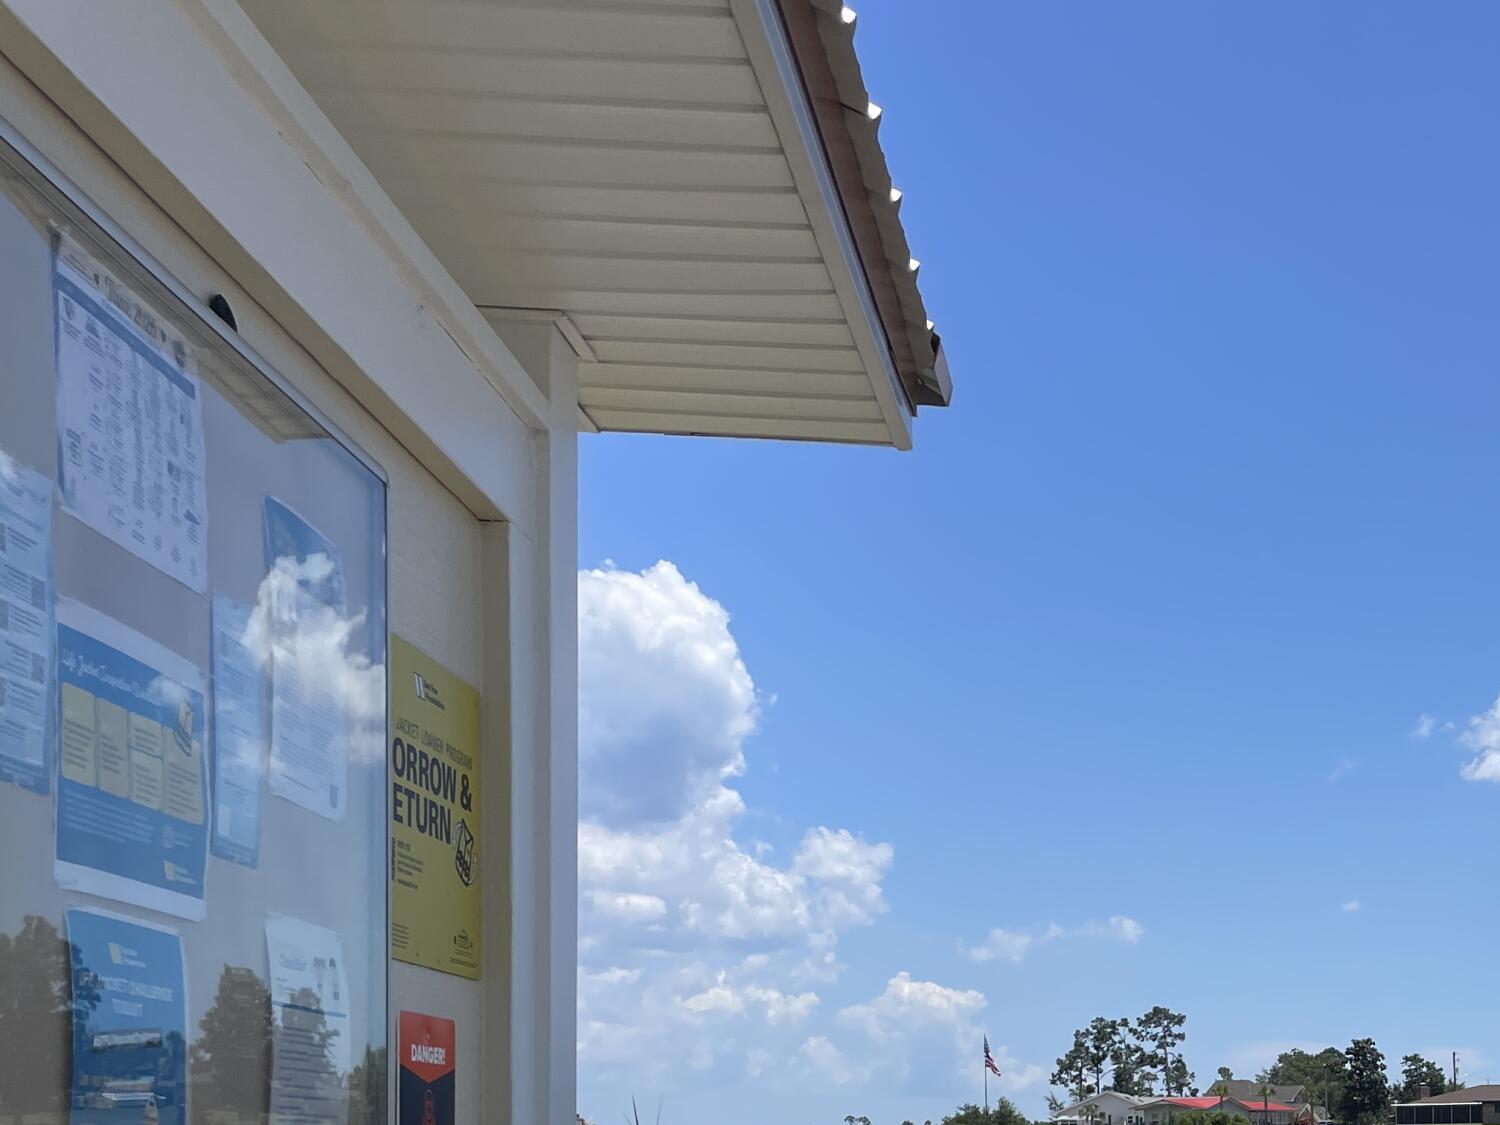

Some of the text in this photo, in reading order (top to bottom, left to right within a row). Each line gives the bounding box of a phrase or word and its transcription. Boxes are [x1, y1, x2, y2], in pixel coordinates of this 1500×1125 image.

[392, 737, 472, 812] ORROW &
[392, 782, 451, 845] ETURN
[411, 1043, 446, 1065] DANGER!
